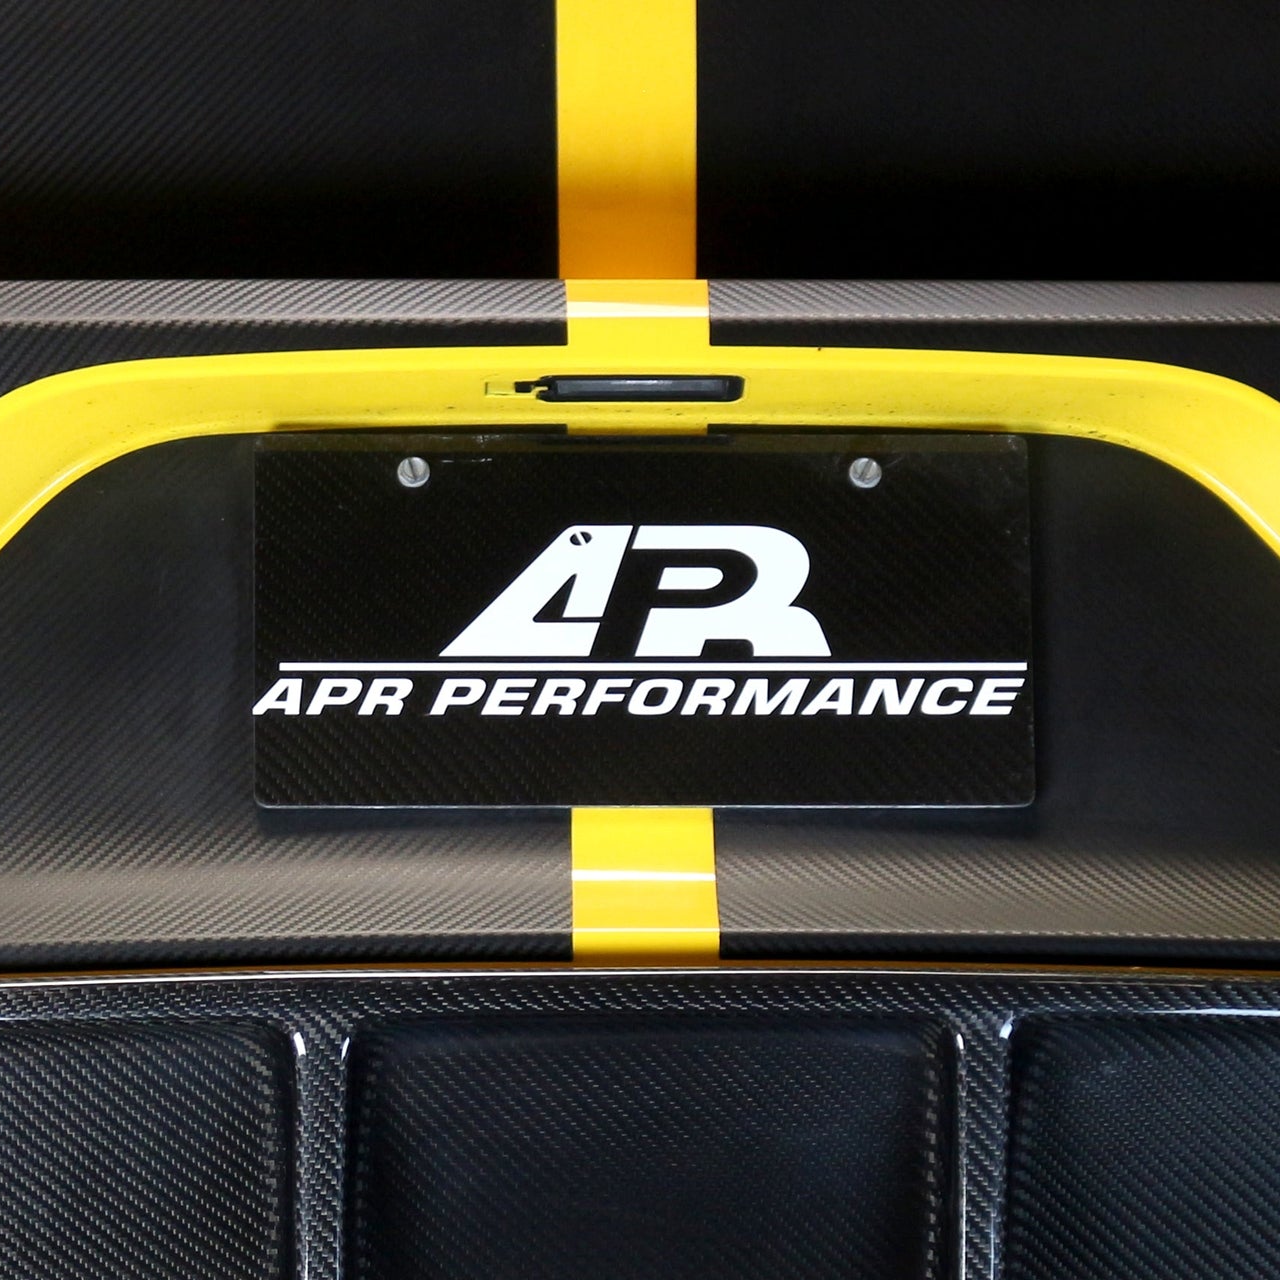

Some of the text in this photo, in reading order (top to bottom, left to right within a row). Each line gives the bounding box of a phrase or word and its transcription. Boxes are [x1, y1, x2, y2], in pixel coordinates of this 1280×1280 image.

[438, 525, 832, 657] APR
[252, 678, 1025, 716] APR PERFORMANCE
